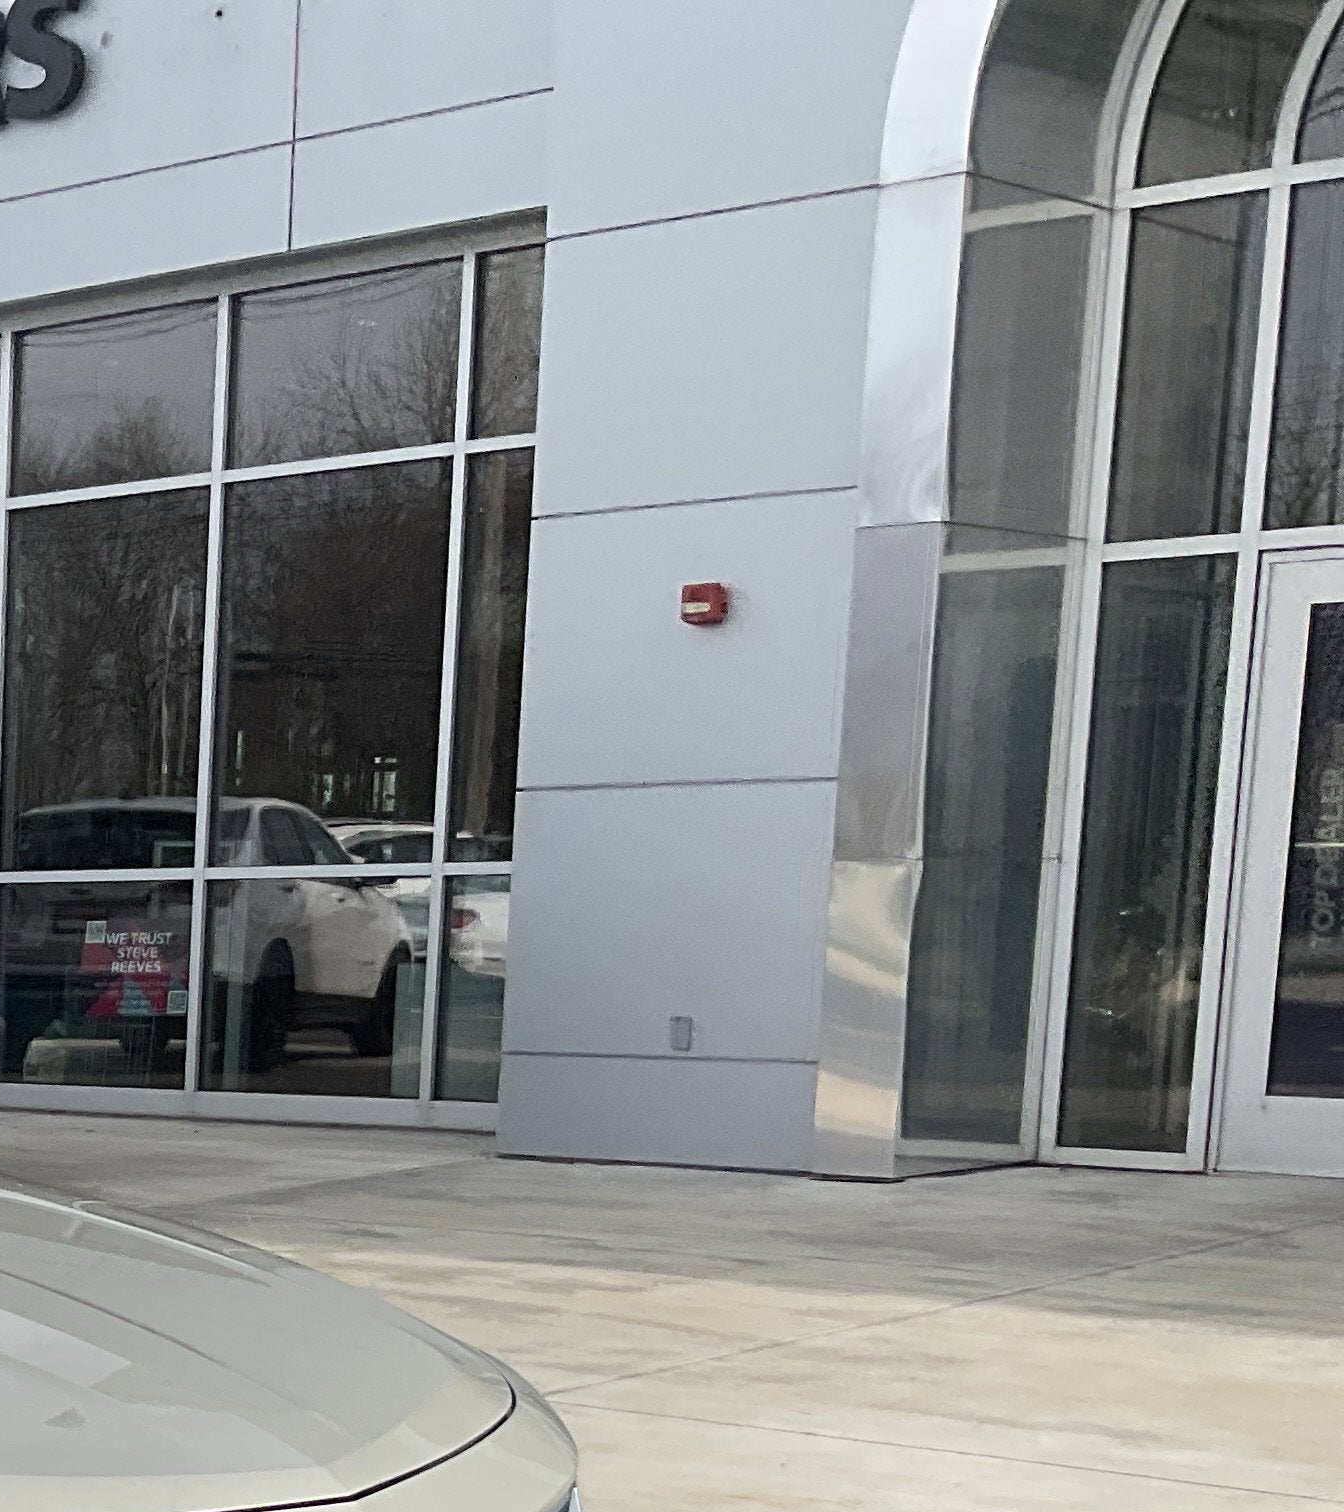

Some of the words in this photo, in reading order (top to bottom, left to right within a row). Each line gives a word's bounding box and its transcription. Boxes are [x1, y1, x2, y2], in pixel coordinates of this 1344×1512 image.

[106, 932, 128, 945] WE
[132, 931, 172, 945] TRUST
[117, 947, 158, 959] STEVE
[111, 961, 161, 973] REEVES
